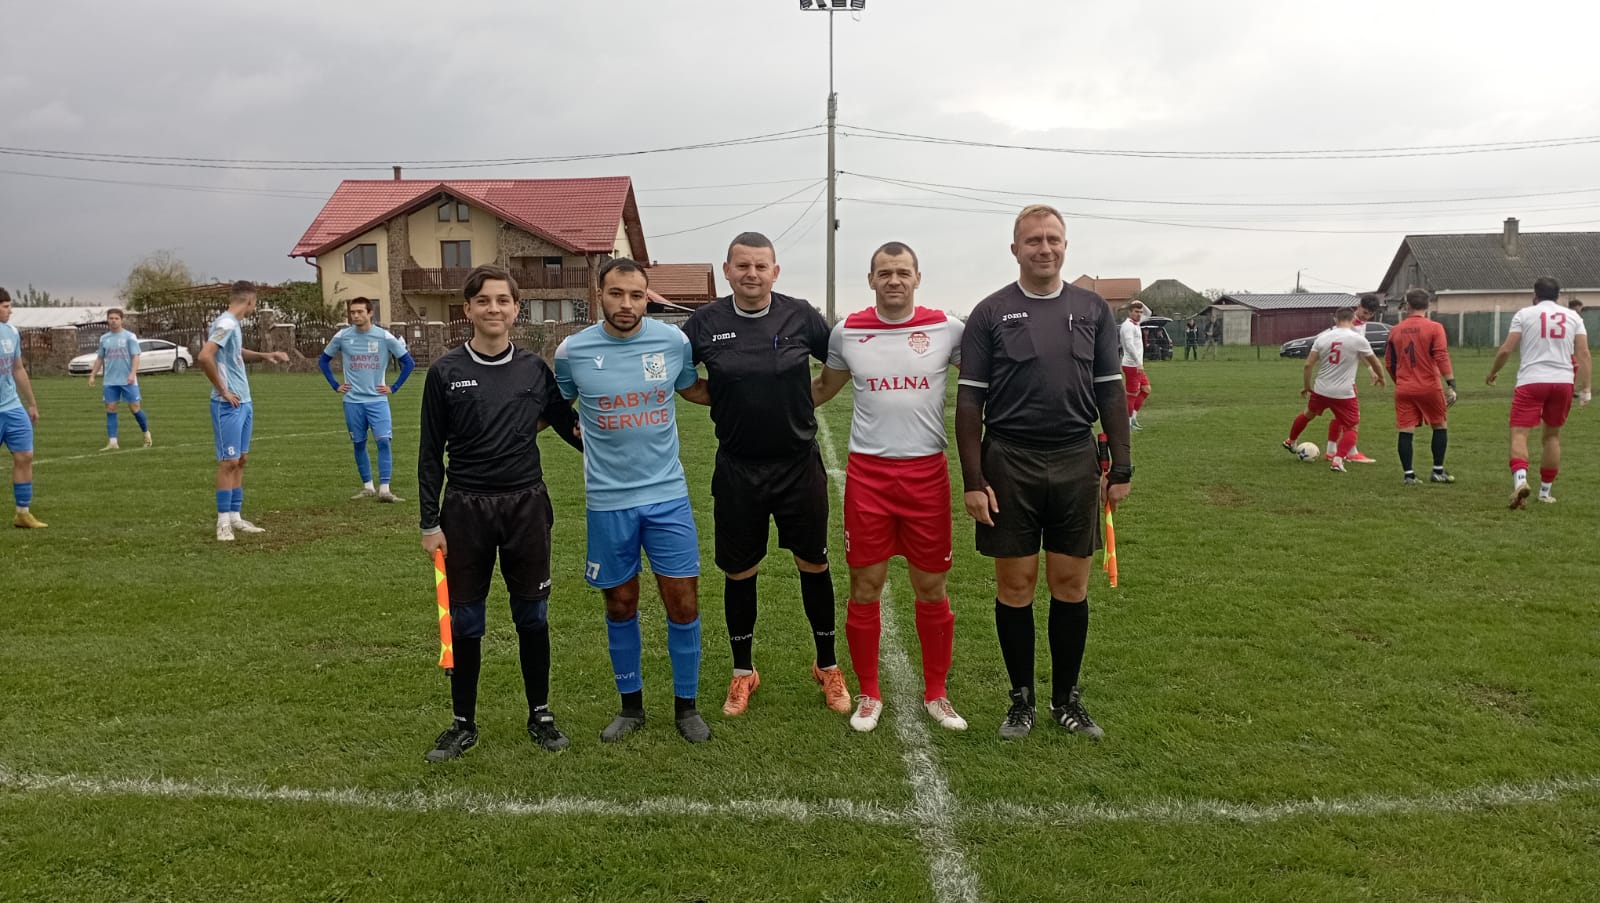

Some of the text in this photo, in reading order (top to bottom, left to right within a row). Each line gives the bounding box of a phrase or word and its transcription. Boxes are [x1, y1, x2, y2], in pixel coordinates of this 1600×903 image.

[1539, 312, 1567, 339] 13
[1329, 342, 1342, 364] 5
[1404, 341, 1416, 369] 1
[866, 376, 930, 391] TALNA
[598, 386, 667, 411] GABY'S
[597, 408, 669, 430] SERVICE
